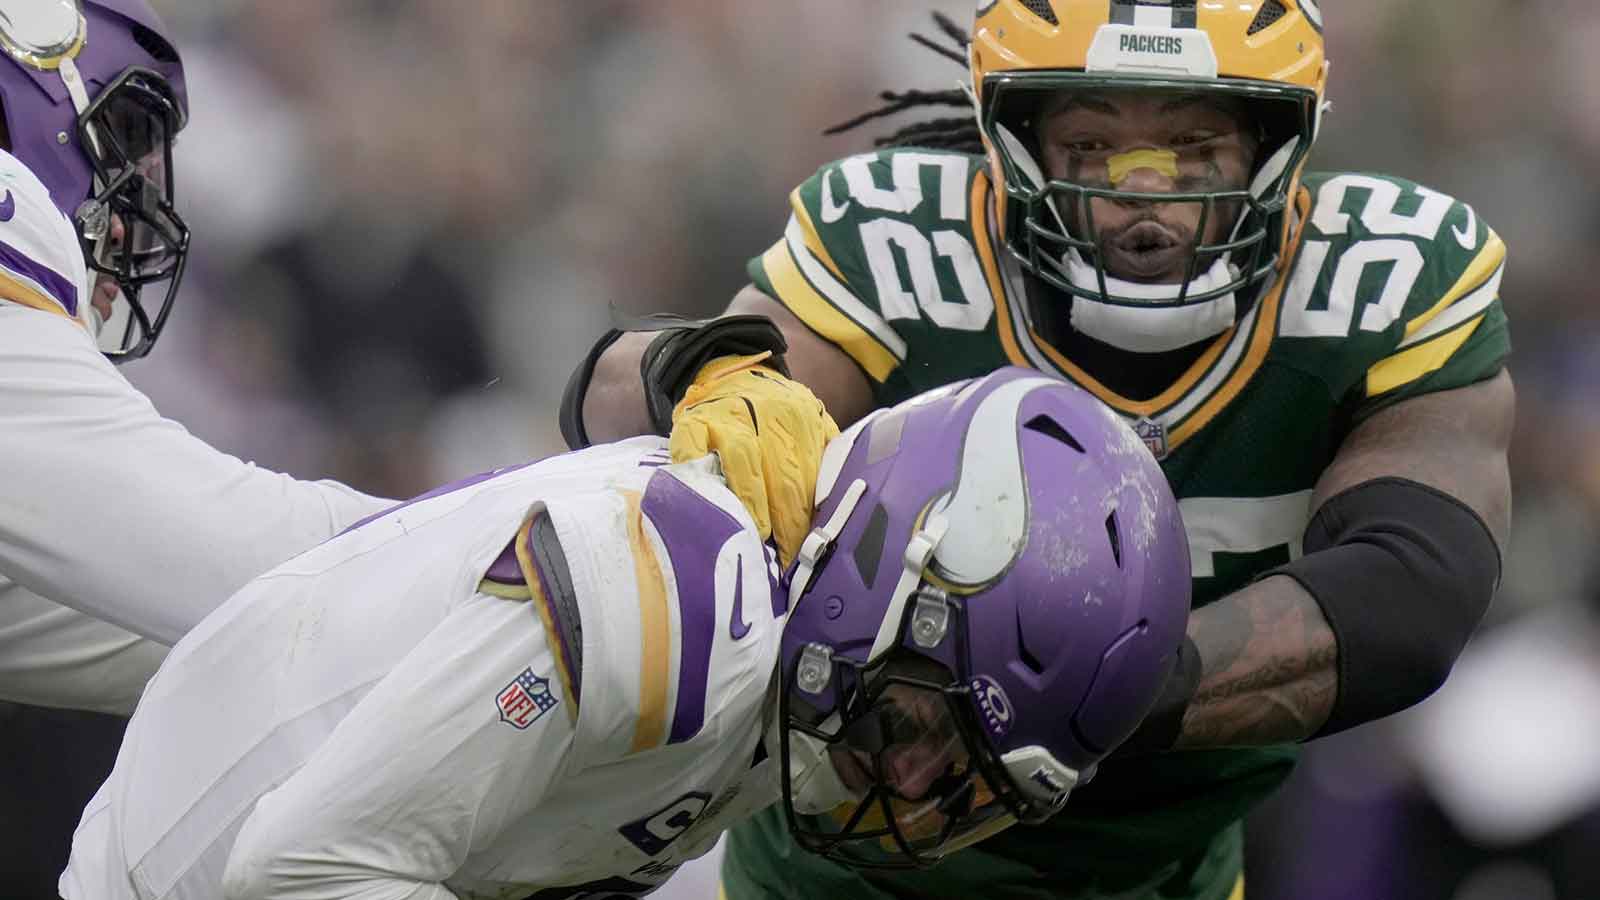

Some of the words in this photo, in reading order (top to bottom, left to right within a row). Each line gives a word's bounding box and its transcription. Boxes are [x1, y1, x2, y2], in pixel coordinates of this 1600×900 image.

[1120, 34, 1182, 54] PACKERS
[840, 152, 995, 331] 52
[1279, 174, 1455, 338] 52
[500, 684, 538, 725] NFL
[972, 680, 1003, 733] OAKLEY
[645, 796, 708, 841] C
